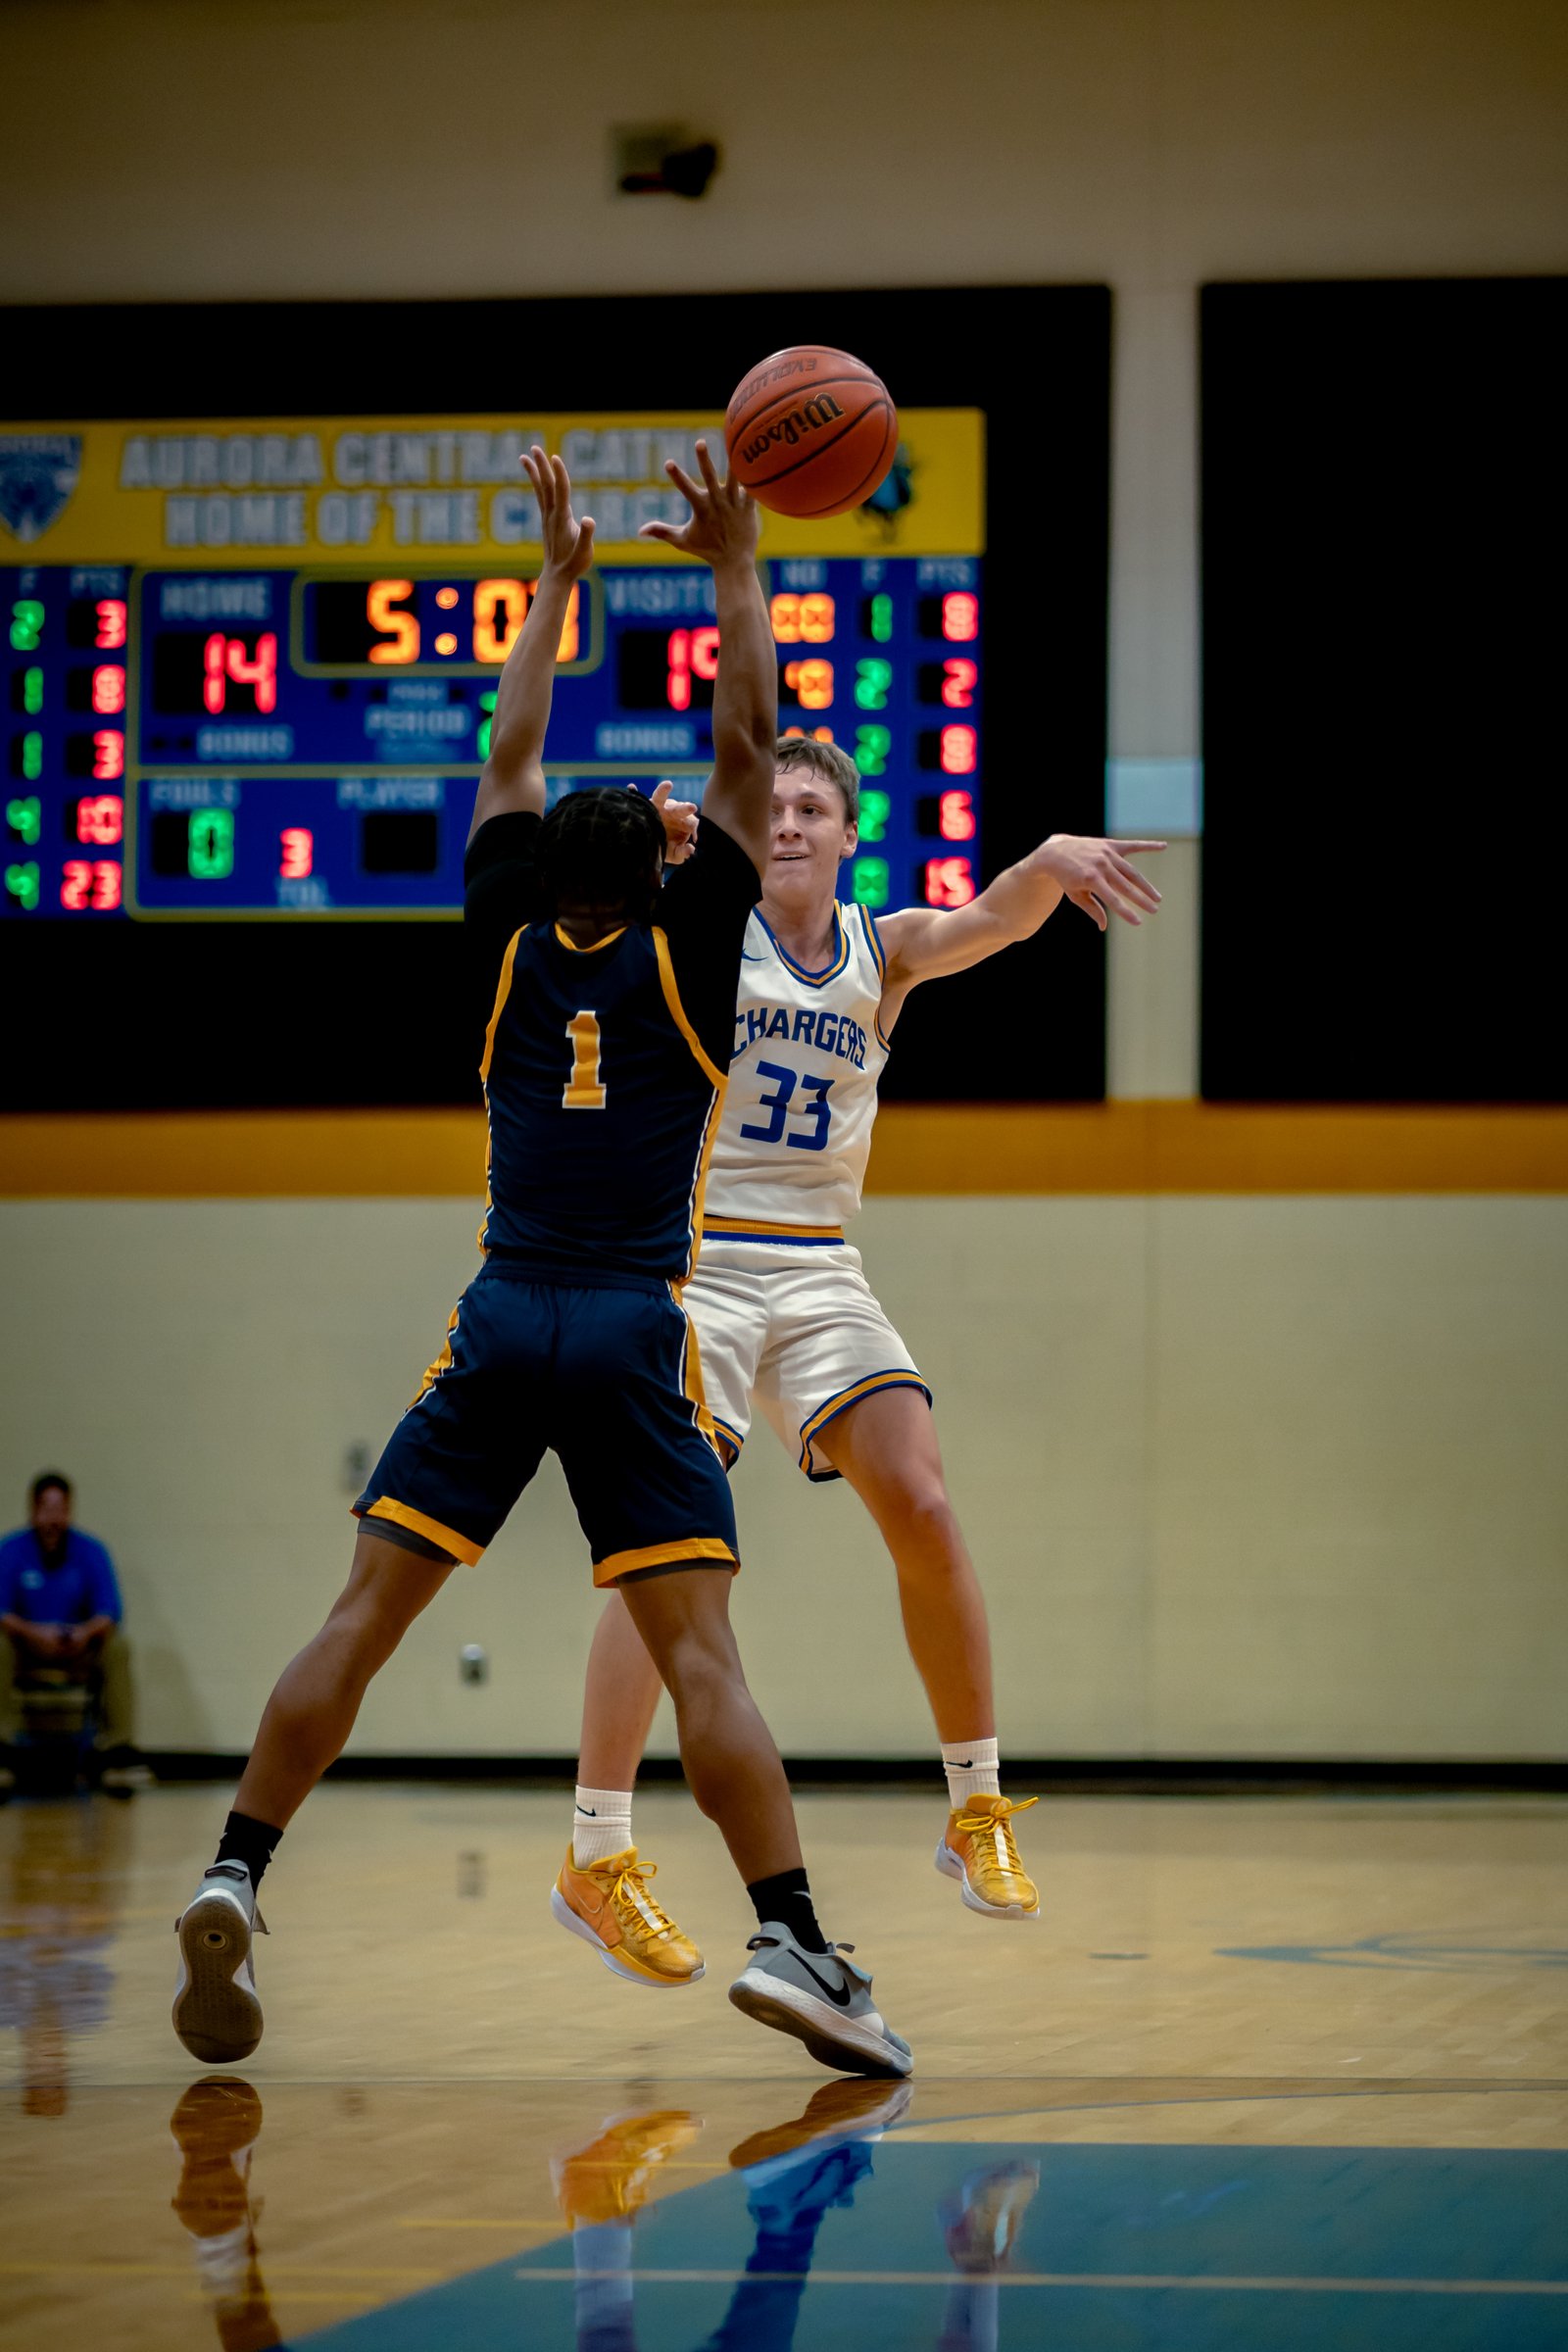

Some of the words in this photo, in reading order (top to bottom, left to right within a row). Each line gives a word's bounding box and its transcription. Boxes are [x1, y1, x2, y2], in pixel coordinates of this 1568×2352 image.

[742, 393, 844, 464] Wilson
[121, 435, 324, 487] AURORA
[335, 431, 546, 485] CENTRAL
[165, 493, 307, 546] HOME
[317, 492, 377, 545] OF
[392, 491, 481, 545] THE
[10, 600, 44, 650] 2
[95, 600, 126, 648] 3
[871, 593, 893, 643] 1
[24, 667, 43, 714] 1
[204, 632, 277, 714] 14
[855, 659, 893, 710] 2
[941, 659, 977, 709] 2
[23, 732, 42, 779] 1
[92, 730, 124, 779] 3
[854, 724, 890, 775] 2
[939, 790, 976, 841] 6
[188, 808, 234, 879] 0
[280, 828, 313, 878] 3
[61, 860, 122, 909] 23
[562, 1010, 607, 1109] 1
[731, 1007, 866, 1070] CHARGERS
[740, 1060, 835, 1151] 33
